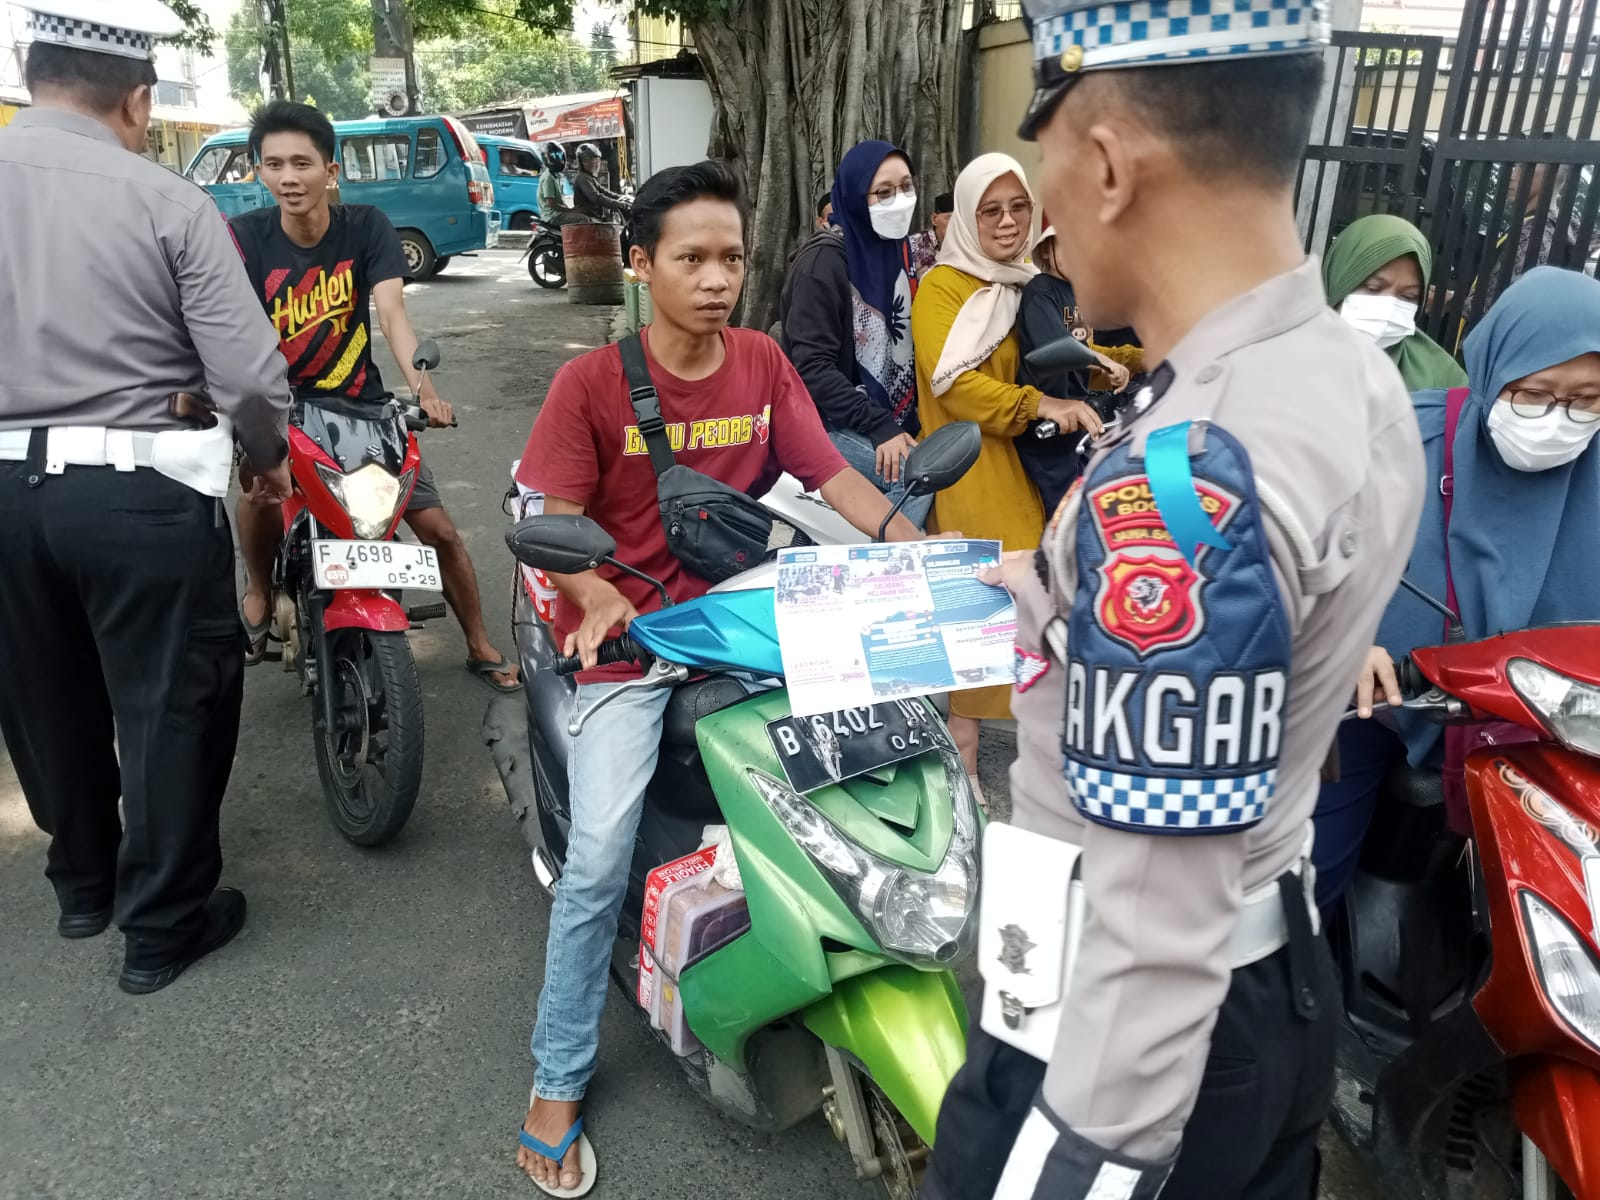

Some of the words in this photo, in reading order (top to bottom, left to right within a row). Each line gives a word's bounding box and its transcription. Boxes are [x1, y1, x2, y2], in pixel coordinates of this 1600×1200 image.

[271, 269, 354, 344] Hurley
[688, 415, 753, 450] PEDAS
[319, 545, 330, 563] F
[345, 545, 393, 563] 4698
[415, 549, 435, 568] JE
[776, 725, 801, 756] B
[663, 860, 709, 884] FRAGILE
